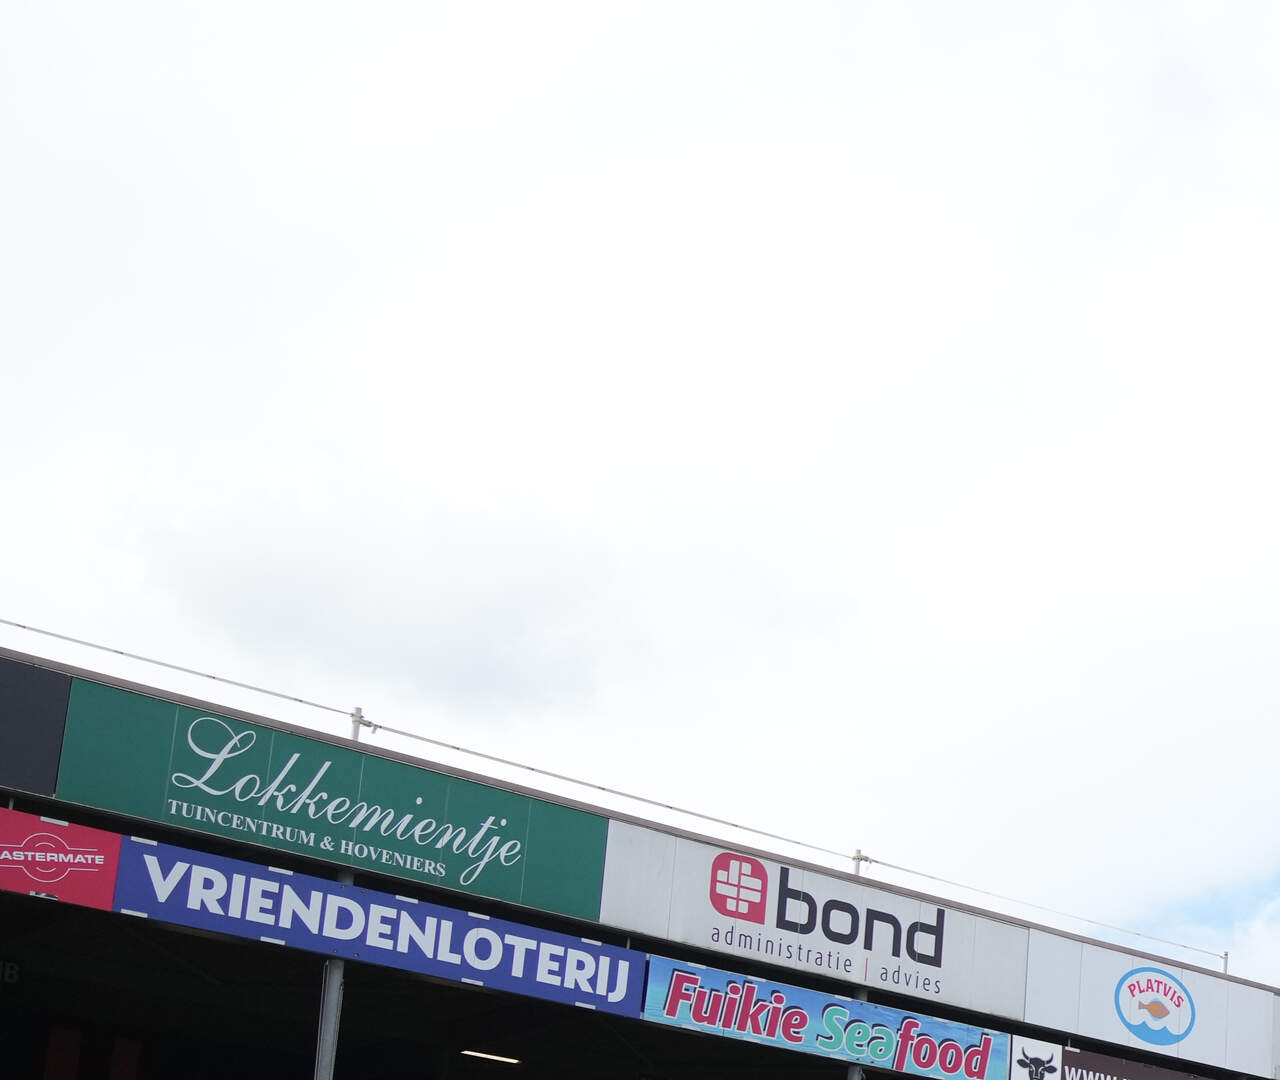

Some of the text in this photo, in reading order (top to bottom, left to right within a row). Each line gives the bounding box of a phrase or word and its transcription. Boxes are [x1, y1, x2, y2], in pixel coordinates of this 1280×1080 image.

[168, 798, 447, 878] TUINCENTRUM & HOVENIERS
[172, 716, 521, 885] Lokkemientje
[0, 848, 104, 865] ASTERMATE
[143, 854, 630, 1003] VRIENDENLOTERIJ
[775, 865, 945, 969] bond
[711, 924, 942, 995] administratie advies
[1127, 979, 1185, 1010] PLATVIS
[663, 969, 806, 1044] Fuikie
